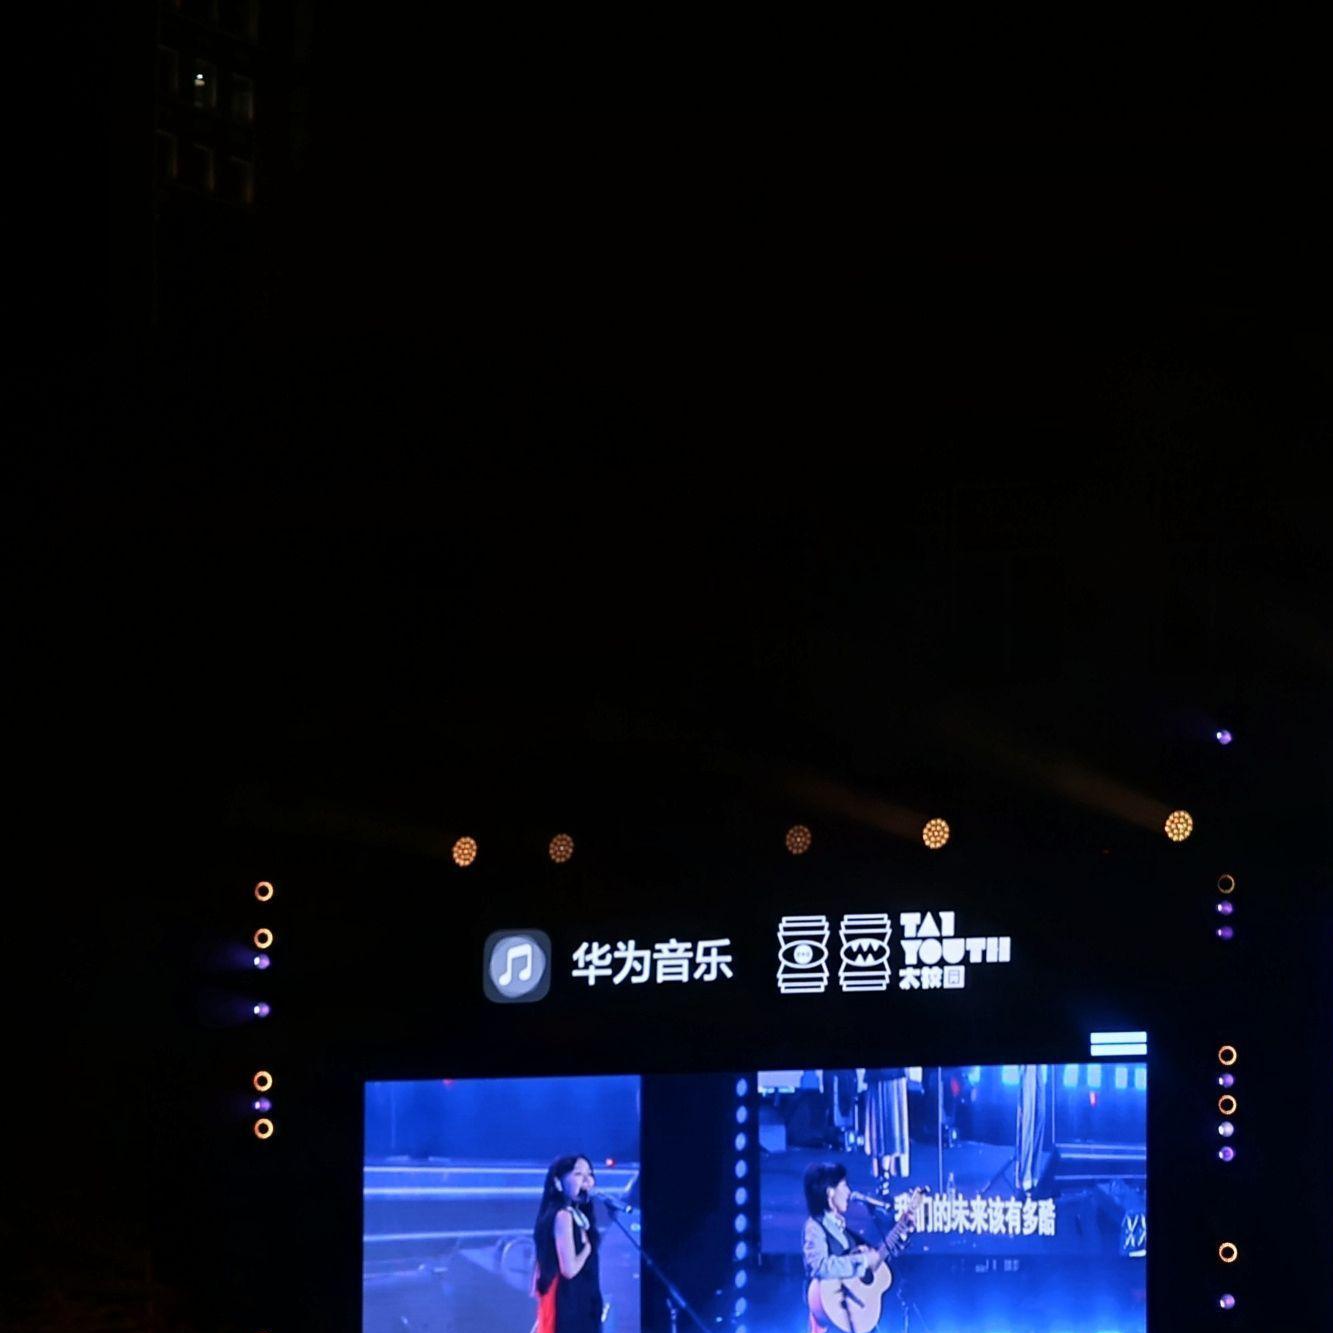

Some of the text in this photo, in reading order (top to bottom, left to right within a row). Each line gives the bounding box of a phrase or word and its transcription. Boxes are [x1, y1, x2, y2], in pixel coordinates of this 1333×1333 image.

[900, 911, 955, 938] TAI
[571, 938, 734, 986] 华为音乐
[900, 936, 1011, 966] YOUTH
